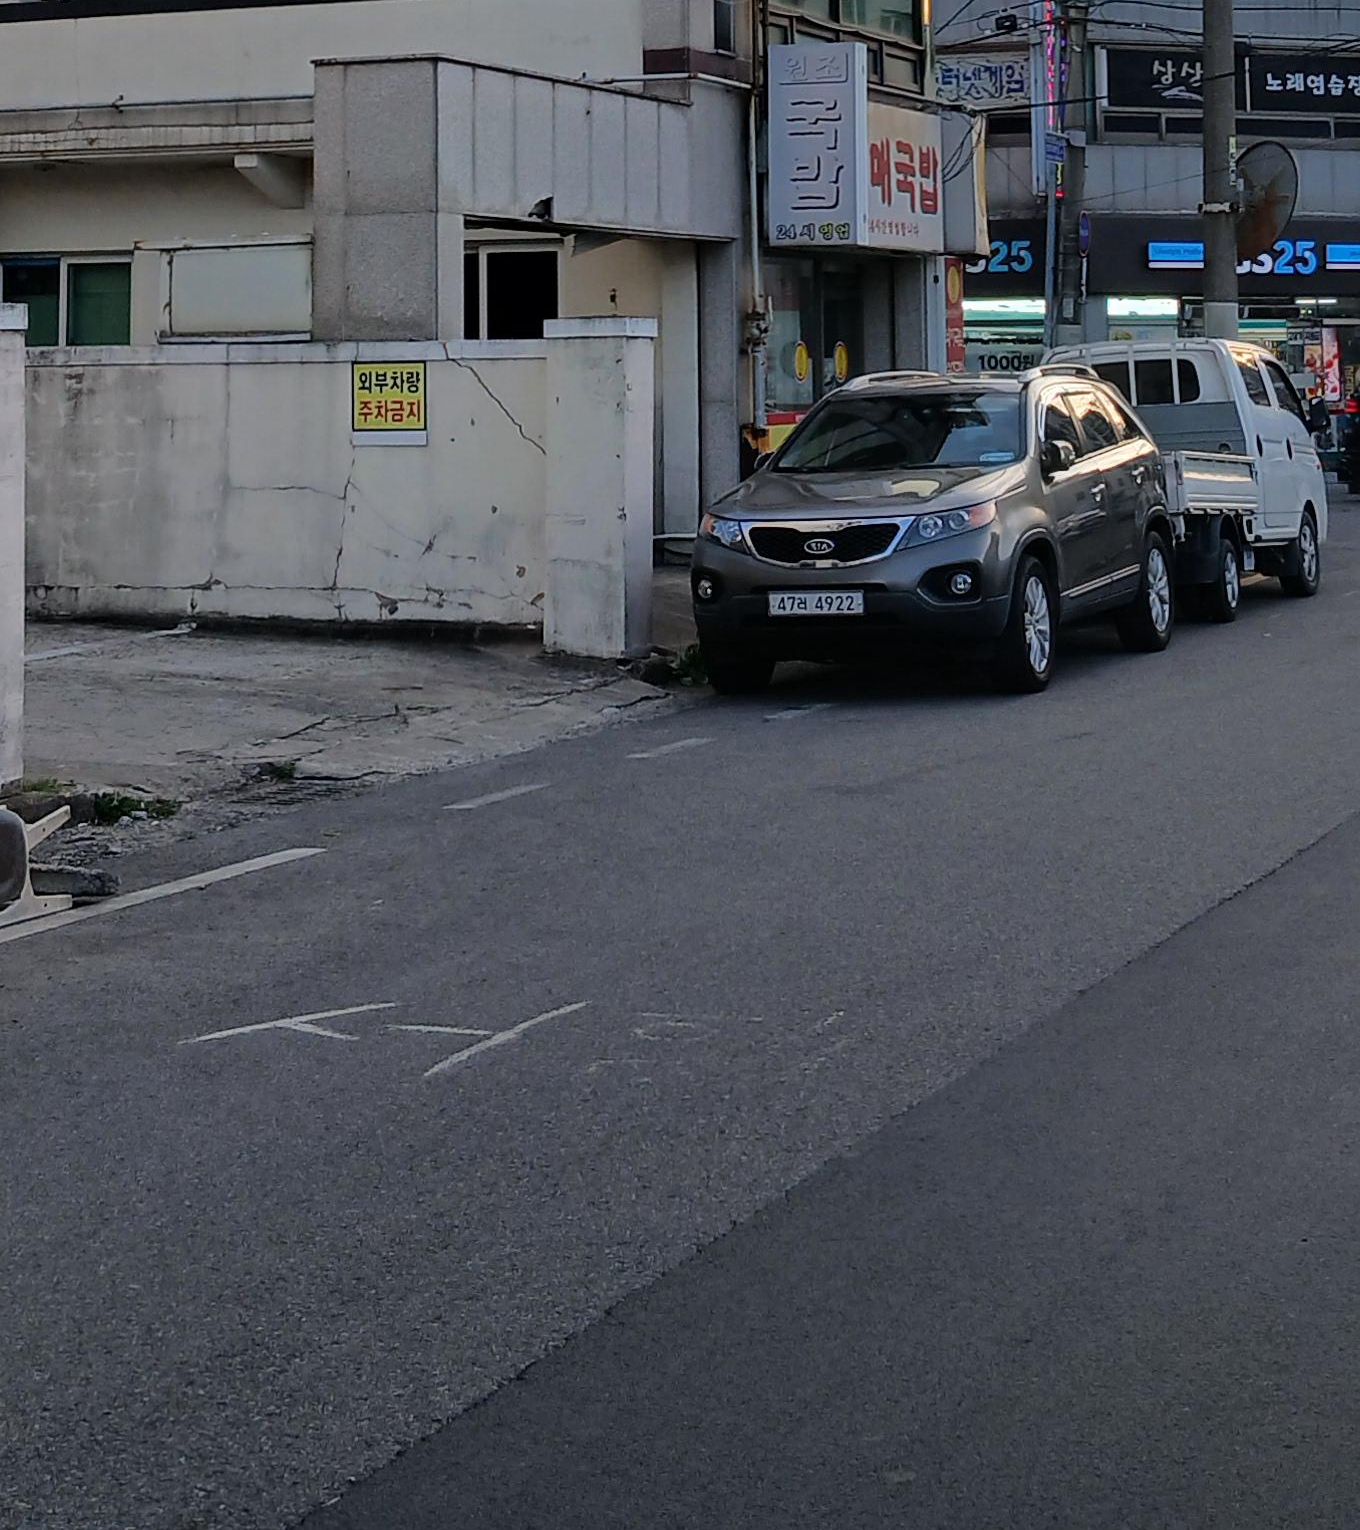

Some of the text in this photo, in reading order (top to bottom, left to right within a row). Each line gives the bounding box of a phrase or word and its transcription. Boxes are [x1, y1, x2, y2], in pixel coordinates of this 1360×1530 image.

[785, 54, 843, 82] 원조
[936, 64, 1025, 99] 터넷게임
[786, 99, 844, 210] 국밥
[776, 223, 850, 241] 24시 영업
[358, 371, 421, 394] 외부차량
[358, 400, 421, 422] 주차금지
[815, 595, 855, 611] 4922
